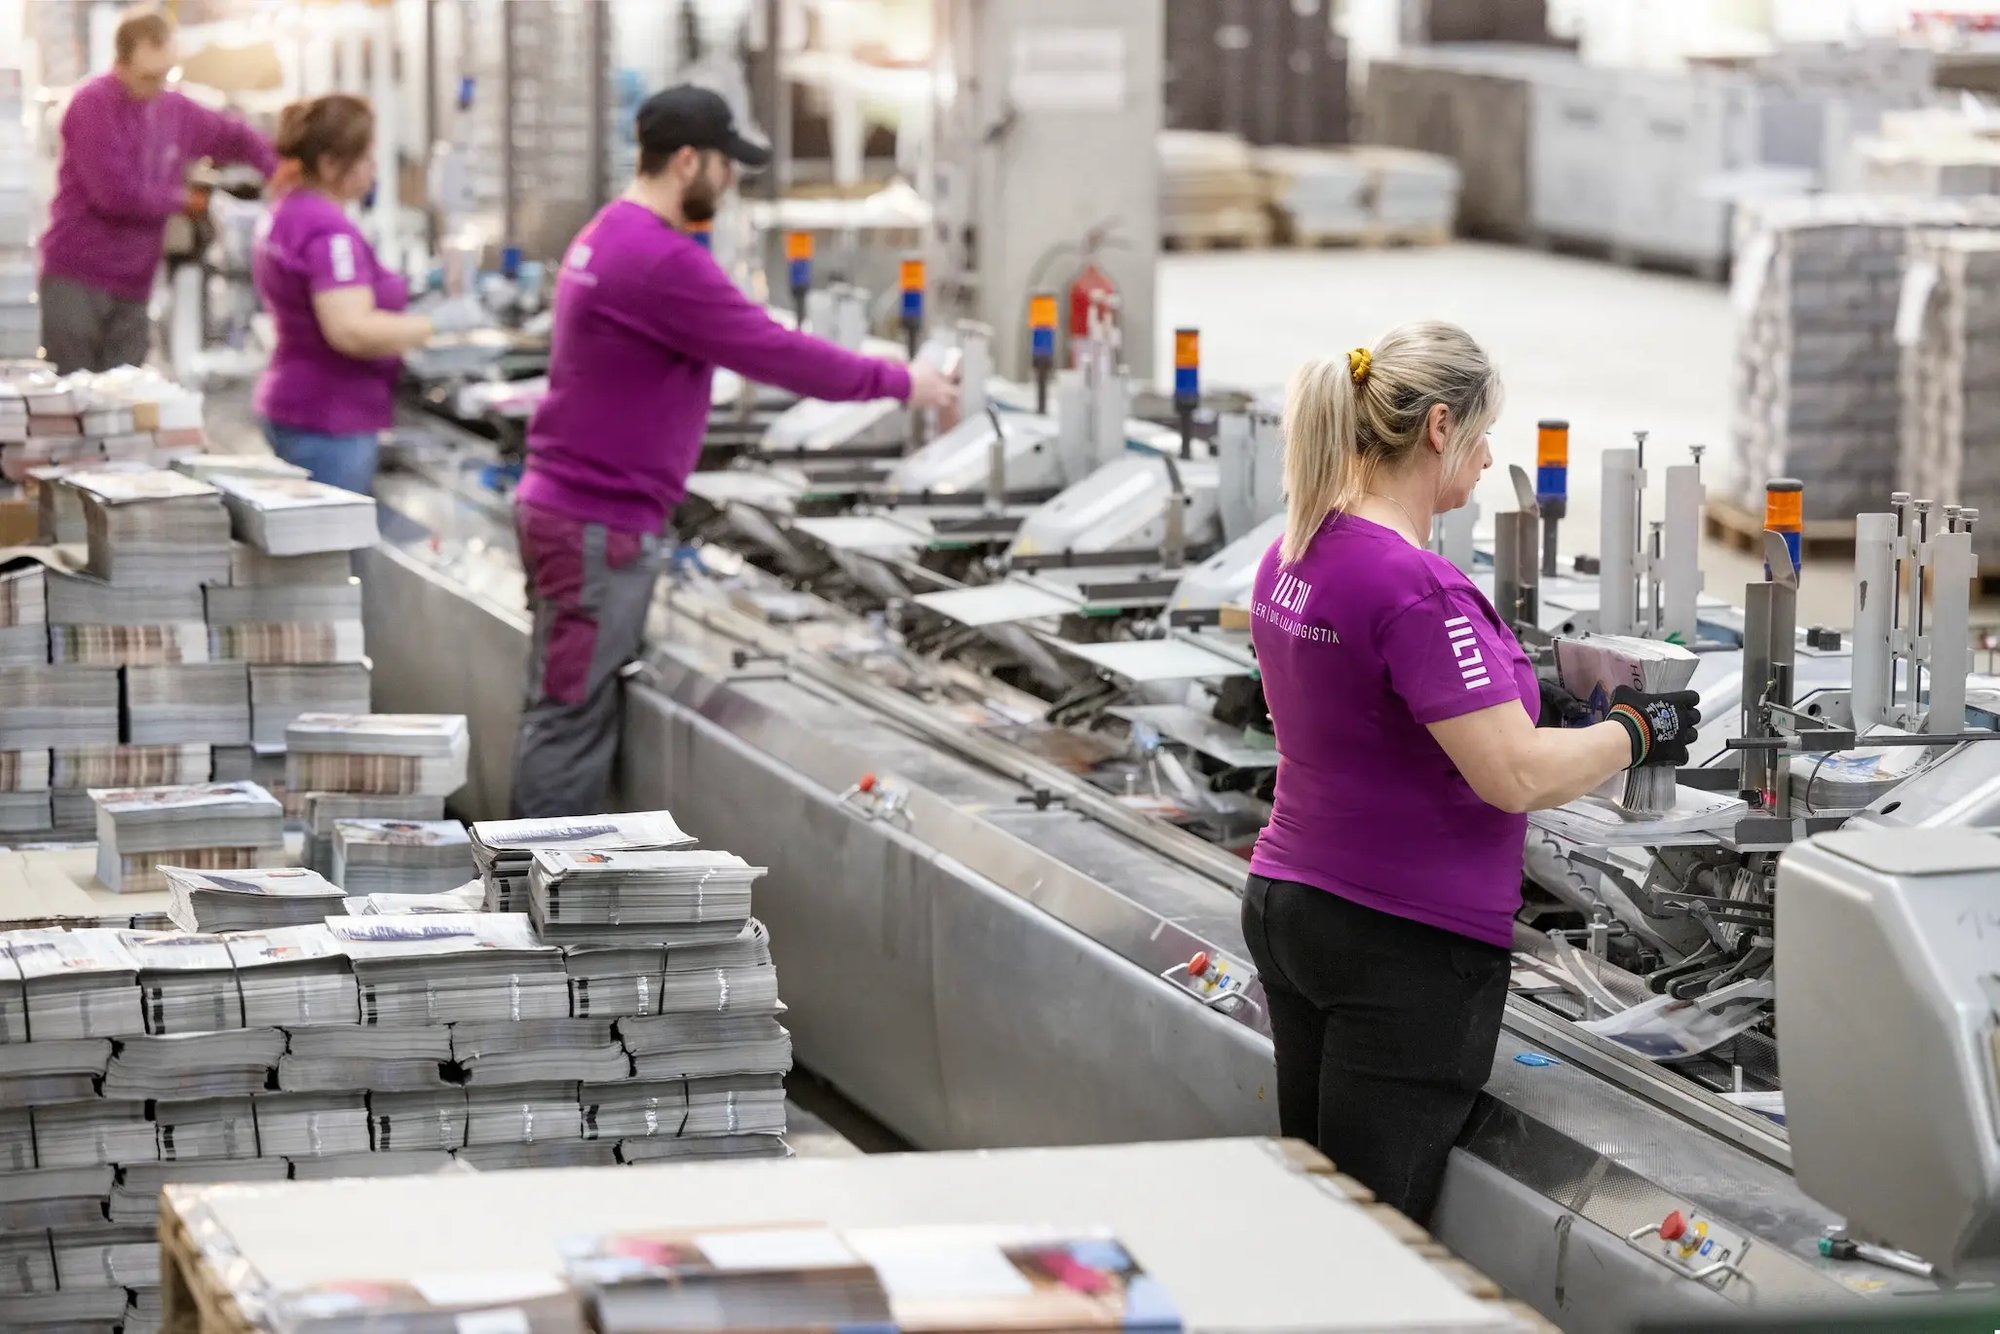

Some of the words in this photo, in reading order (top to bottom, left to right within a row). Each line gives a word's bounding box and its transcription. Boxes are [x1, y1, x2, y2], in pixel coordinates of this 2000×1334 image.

[1270, 609, 1279, 625] DIE
[1280, 615, 1293, 635] LILA
[1292, 623, 1340, 644] LOGISTIK
